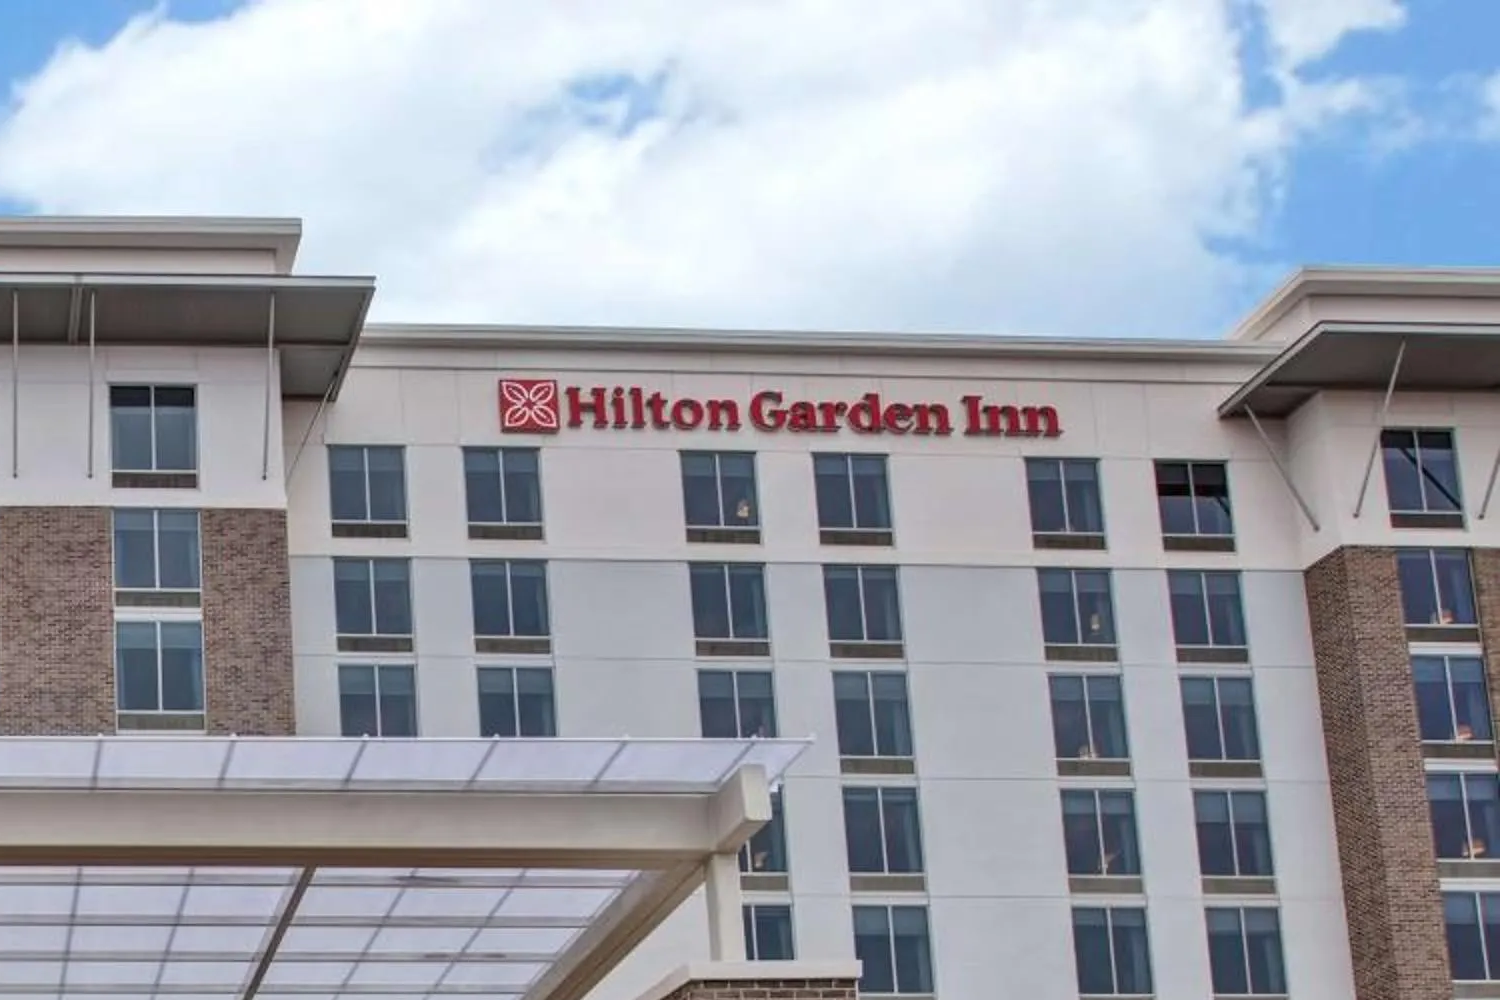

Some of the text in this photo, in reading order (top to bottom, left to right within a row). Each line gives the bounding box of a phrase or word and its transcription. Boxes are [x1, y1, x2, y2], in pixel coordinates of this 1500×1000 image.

[565, 385, 1064, 439] Hilton Garden Inn
